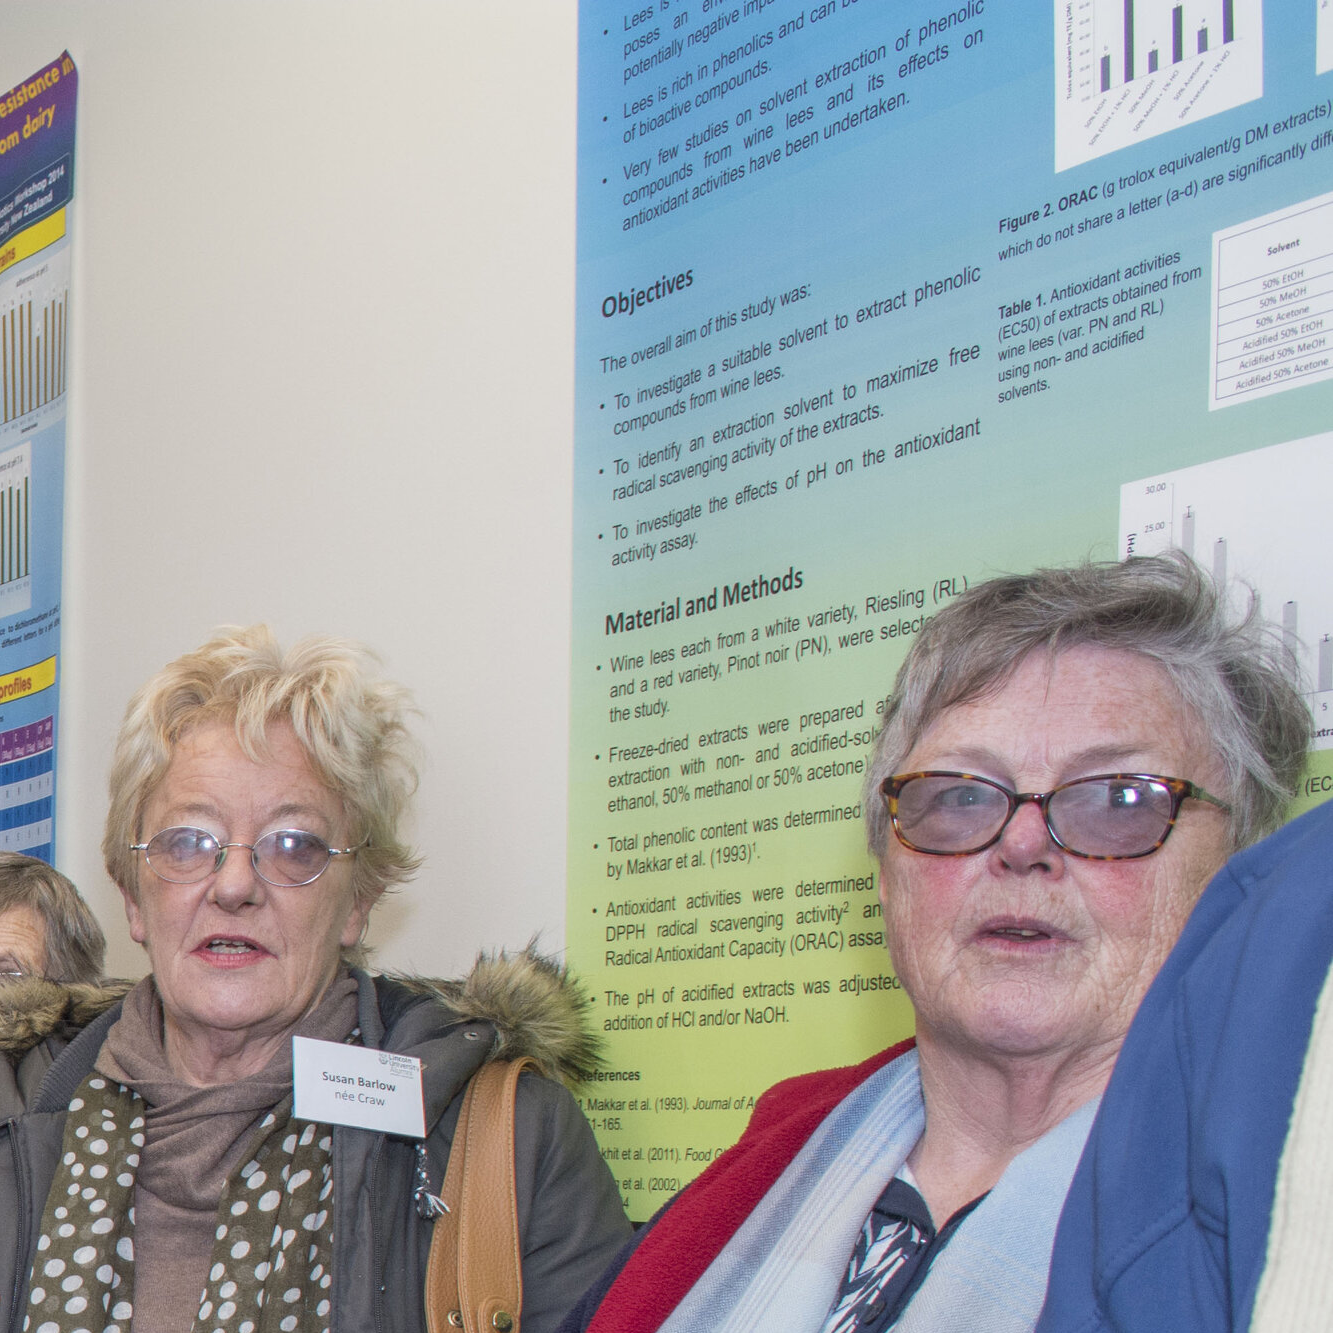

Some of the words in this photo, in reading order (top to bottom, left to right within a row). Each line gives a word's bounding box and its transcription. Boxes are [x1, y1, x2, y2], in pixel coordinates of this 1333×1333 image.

[59, 56, 74, 76] in
[622, 158, 651, 180] Very
[657, 144, 679, 165] few
[685, 120, 729, 151] studies
[735, 108, 751, 126] on
[759, 78, 807, 115] solvent
[815, 45, 886, 88] extraction
[895, 28, 910, 51] of
[918, 2, 984, 46] phenolic
[22, 104, 55, 139] dairy
[48, 164, 65, 185] 2014
[622, 188, 689, 231] antioxidant
[691, 164, 745, 200] activities
[749, 148, 781, 173] have
[785, 130, 818, 157] been
[823, 92, 910, 139] undertaken.
[999, 210, 1040, 233] Figure
[1043, 202, 1054, 218] 2.
[1058, 185, 1098, 211] ORAC
[1102, 181, 1114, 199] (g
[1118, 167, 1155, 190] trolox
[1158, 136, 1241, 175] equivalent/g
[1245, 122, 1268, 145] DM
[1273, 99, 1331, 134] extracts)
[24, 189, 53, 217] Zealand
[1267, 238, 1300, 256] Solvent
[601, 269, 693, 318] Objectives
[998, 298, 1031, 319] Table
[1035, 293, 1046, 307] 1.
[1050, 268, 1121, 303] Antioxidant
[1124, 251, 1180, 279] activities
[599, 355, 627, 373] The
[630, 334, 672, 365] overall
[675, 328, 696, 348] aim
[700, 317, 713, 338] of
[715, 311, 737, 332] this
[741, 295, 776, 322] study
[779, 283, 811, 307] was:
[613, 392, 630, 410] To
[637, 368, 702, 404] investigate
[707, 363, 715, 377] a
[721, 341, 772, 372] suitable
[778, 318, 828, 351] solvent
[834, 313, 848, 331] to
[855, 290, 907, 323] extract
[914, 265, 981, 307] phenolic
[612, 457, 629, 475] To
[638, 441, 682, 469] identify
[689, 435, 704, 452] an
[712, 411, 774, 444] extraction
[783, 388, 833, 420] solvent
[842, 384, 857, 401] to
[866, 358, 938, 393] maximize
[948, 344, 980, 367] free
[613, 399, 686, 435] compounds
[689, 389, 716, 410] from
[720, 377, 749, 398] wine
[753, 366, 785, 387] lees.
[612, 473, 656, 501] radical
[659, 453, 727, 487] scavenging
[731, 437, 777, 464] activity
[779, 427, 794, 448] of
[796, 424, 818, 443] the
[822, 404, 884, 434] extracts.
[605, 596, 680, 636] Material
[685, 586, 718, 617] and
[722, 565, 804, 608] Methods
[609, 654, 644, 673] Wine
[649, 648, 675, 665] lees
[680, 636, 711, 658] each
[716, 631, 745, 649] from
[751, 627, 759, 641] a
[764, 616, 800, 638] white
[806, 603, 857, 628] variety,
[865, 588, 925, 615] Riesling
[605, 895, 676, 917] Antioxidant
[685, 889, 742, 909] activities
[751, 886, 784, 902] were
[795, 872, 874, 898] determined
[603, 990, 629, 1006] The
[637, 987, 654, 1008] pH
[661, 985, 675, 1003] of
[681, 982, 734, 1002] acidified
[742, 979, 795, 998] extracts
[802, 980, 830, 995] was
[603, 1014, 653, 1031] addition
[655, 1011, 669, 1029] of
[671, 1010, 695, 1028] HCl
[698, 1008, 741, 1026] and/or
[744, 1005, 789, 1024] NaOH.
[322, 1071, 355, 1086] Susan
[358, 1077, 396, 1092] Barlow
[335, 1089, 355, 1102] née
[358, 1094, 386, 1106] Craw
